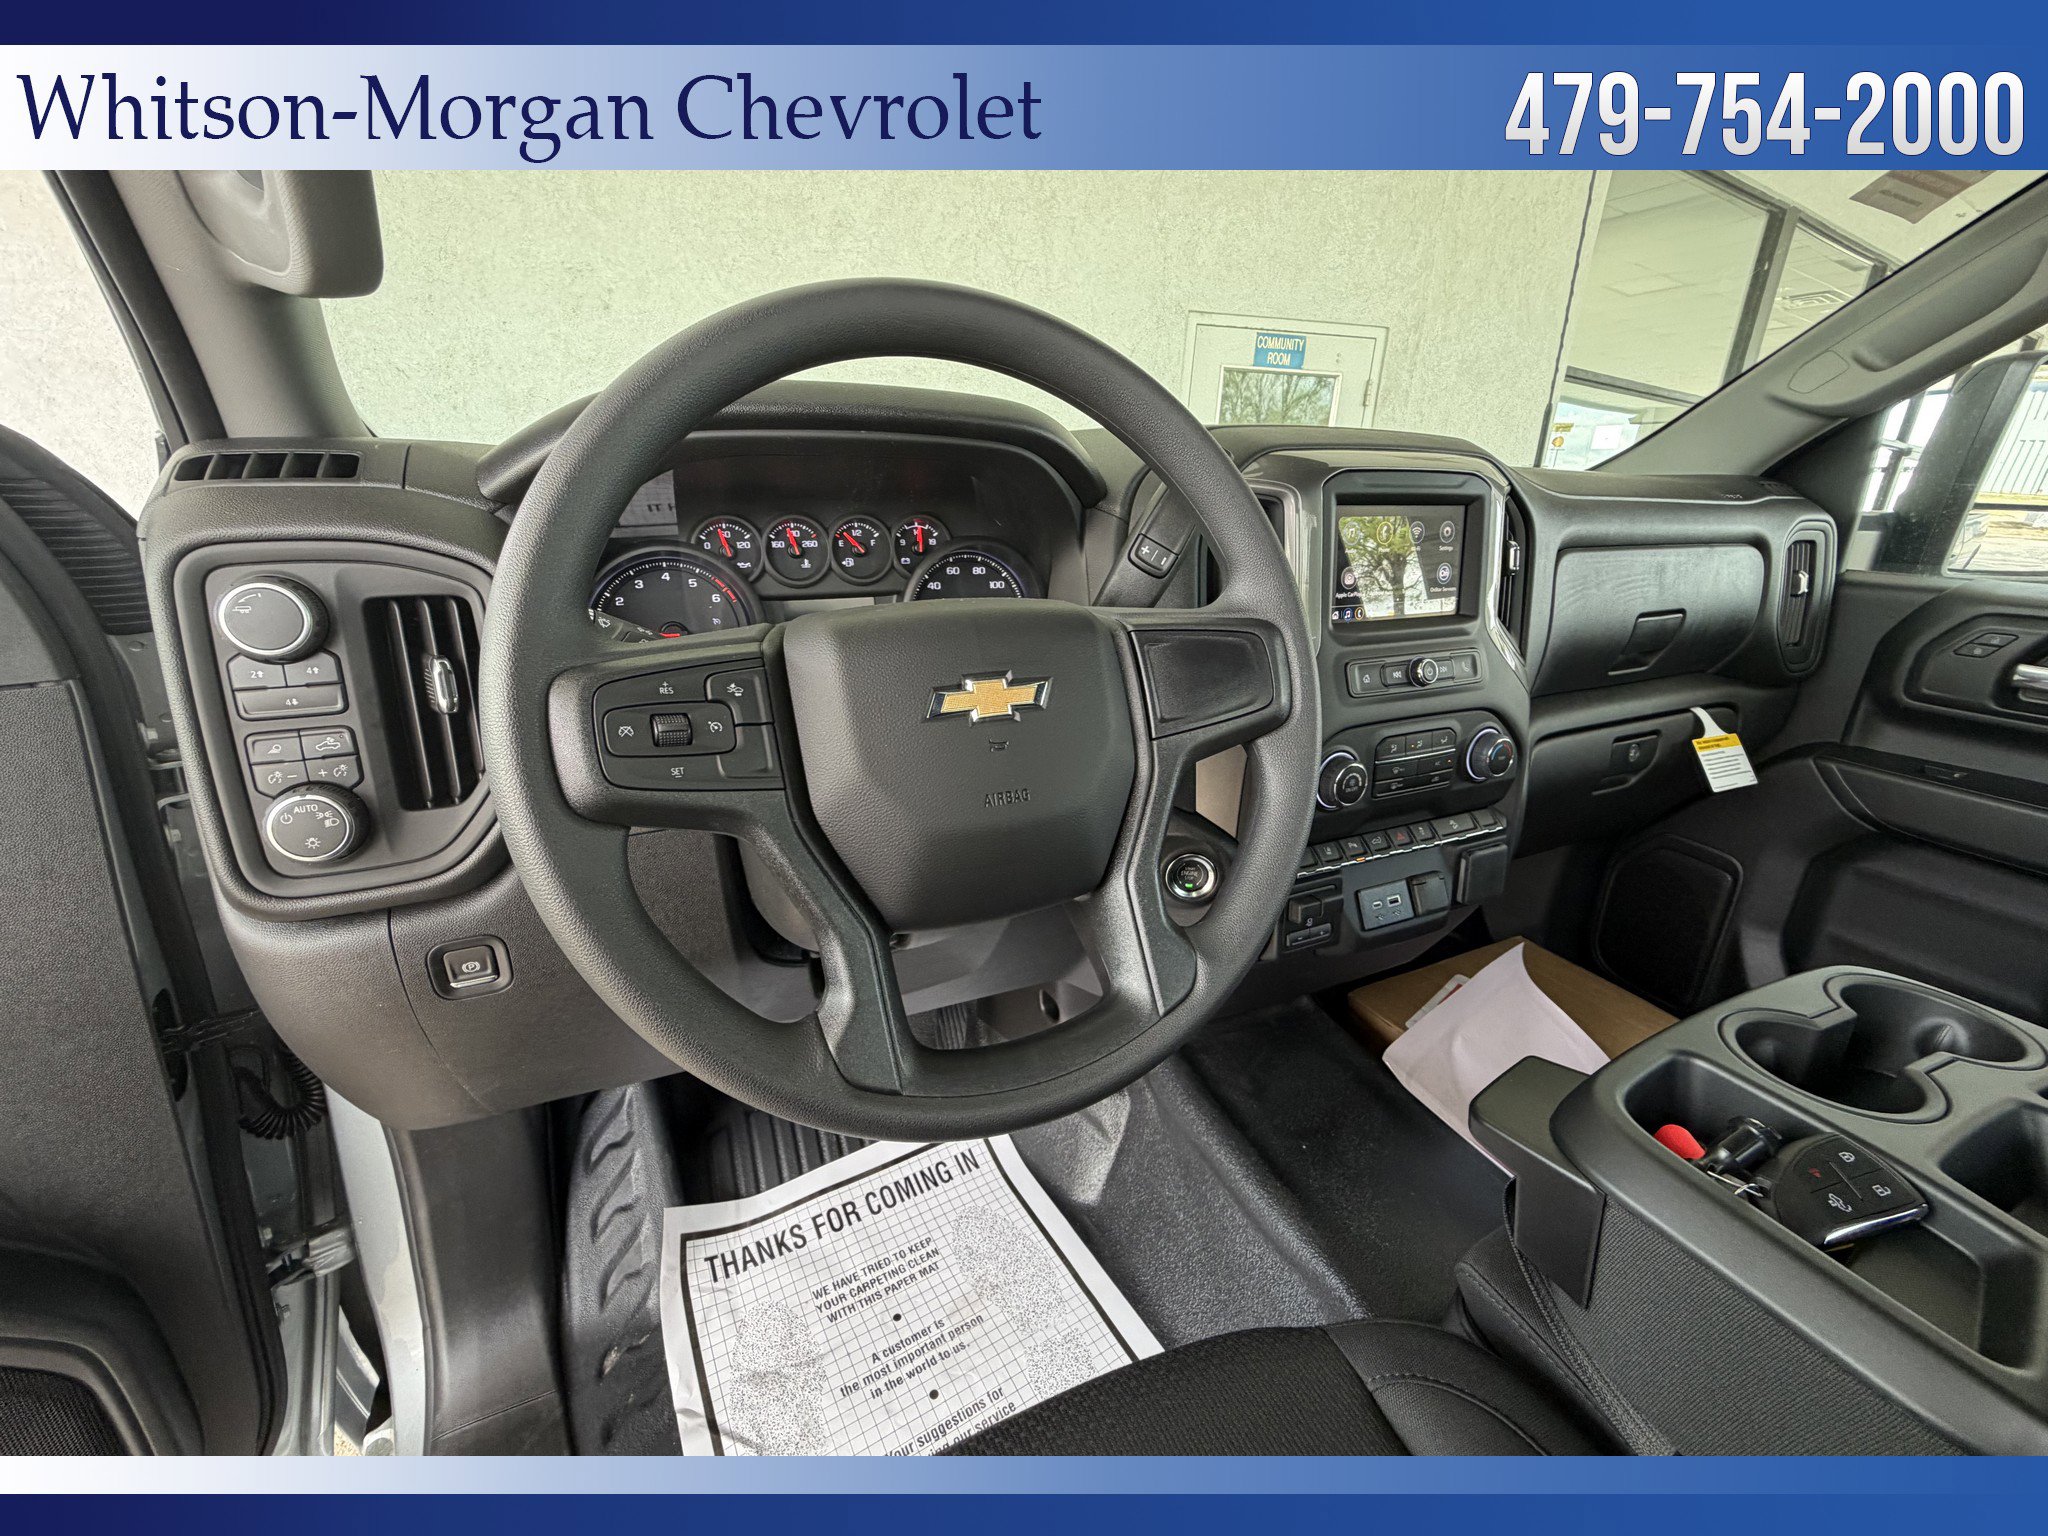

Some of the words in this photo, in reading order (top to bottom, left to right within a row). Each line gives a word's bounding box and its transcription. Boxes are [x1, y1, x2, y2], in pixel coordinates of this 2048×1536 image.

[1257, 336, 1304, 352] COMMUNITY
[1266, 352, 1290, 366] ROOM
[736, 541, 751, 549] 120
[771, 540, 785, 549] 160
[802, 540, 818, 548] 260
[946, 566, 960, 575] 60
[972, 566, 986, 575] 80
[661, 572, 671, 581] 4
[634, 580, 644, 589] 3
[688, 578, 698, 588] 5
[927, 581, 941, 590] 40
[989, 581, 1005, 590] 100
[615, 597, 624, 606] 2
[712, 594, 721, 603] 6
[659, 686, 674, 695] RES
[670, 767, 684, 776] SET
[984, 788, 1031, 808] AIRBAG
[293, 804, 318, 814] AUTO
[704, 1224, 808, 1284] THANKS
[811, 1200, 862, 1240] FOR
[864, 1160, 954, 1216] COMING
[954, 1148, 980, 1176] IN
[812, 1287, 832, 1300] WE
[832, 1272, 861, 1292] HAVE
[861, 1257, 891, 1278] TRIED
[892, 1250, 907, 1261] TO
[908, 1237, 932, 1255] KEEP
[815, 1292, 848, 1314] YOUR
[849, 1264, 907, 1298] CARPETING
[908, 1247, 940, 1269] CLEAN
[826, 1303, 857, 1323] WITH
[856, 1290, 883, 1309] THIS
[884, 1273, 918, 1296] PAPER
[918, 1261, 940, 1277] MAT
[872, 1352, 881, 1364] A
[882, 1325, 932, 1358] customer
[934, 1318, 945, 1330] is
[840, 1381, 860, 1398] the
[862, 1363, 892, 1386] most
[894, 1333, 947, 1370] important
[948, 1314, 984, 1341] person
[870, 1387, 883, 1400] in
[884, 1376, 904, 1392] the
[906, 1356, 938, 1380] world
[938, 1349, 950, 1361] to
[952, 1341, 971, 1354] us.
[916, 1398, 987, 1448] suggestions
[986, 1387, 1004, 1403] for
[975, 1401, 1017, 1432] service
